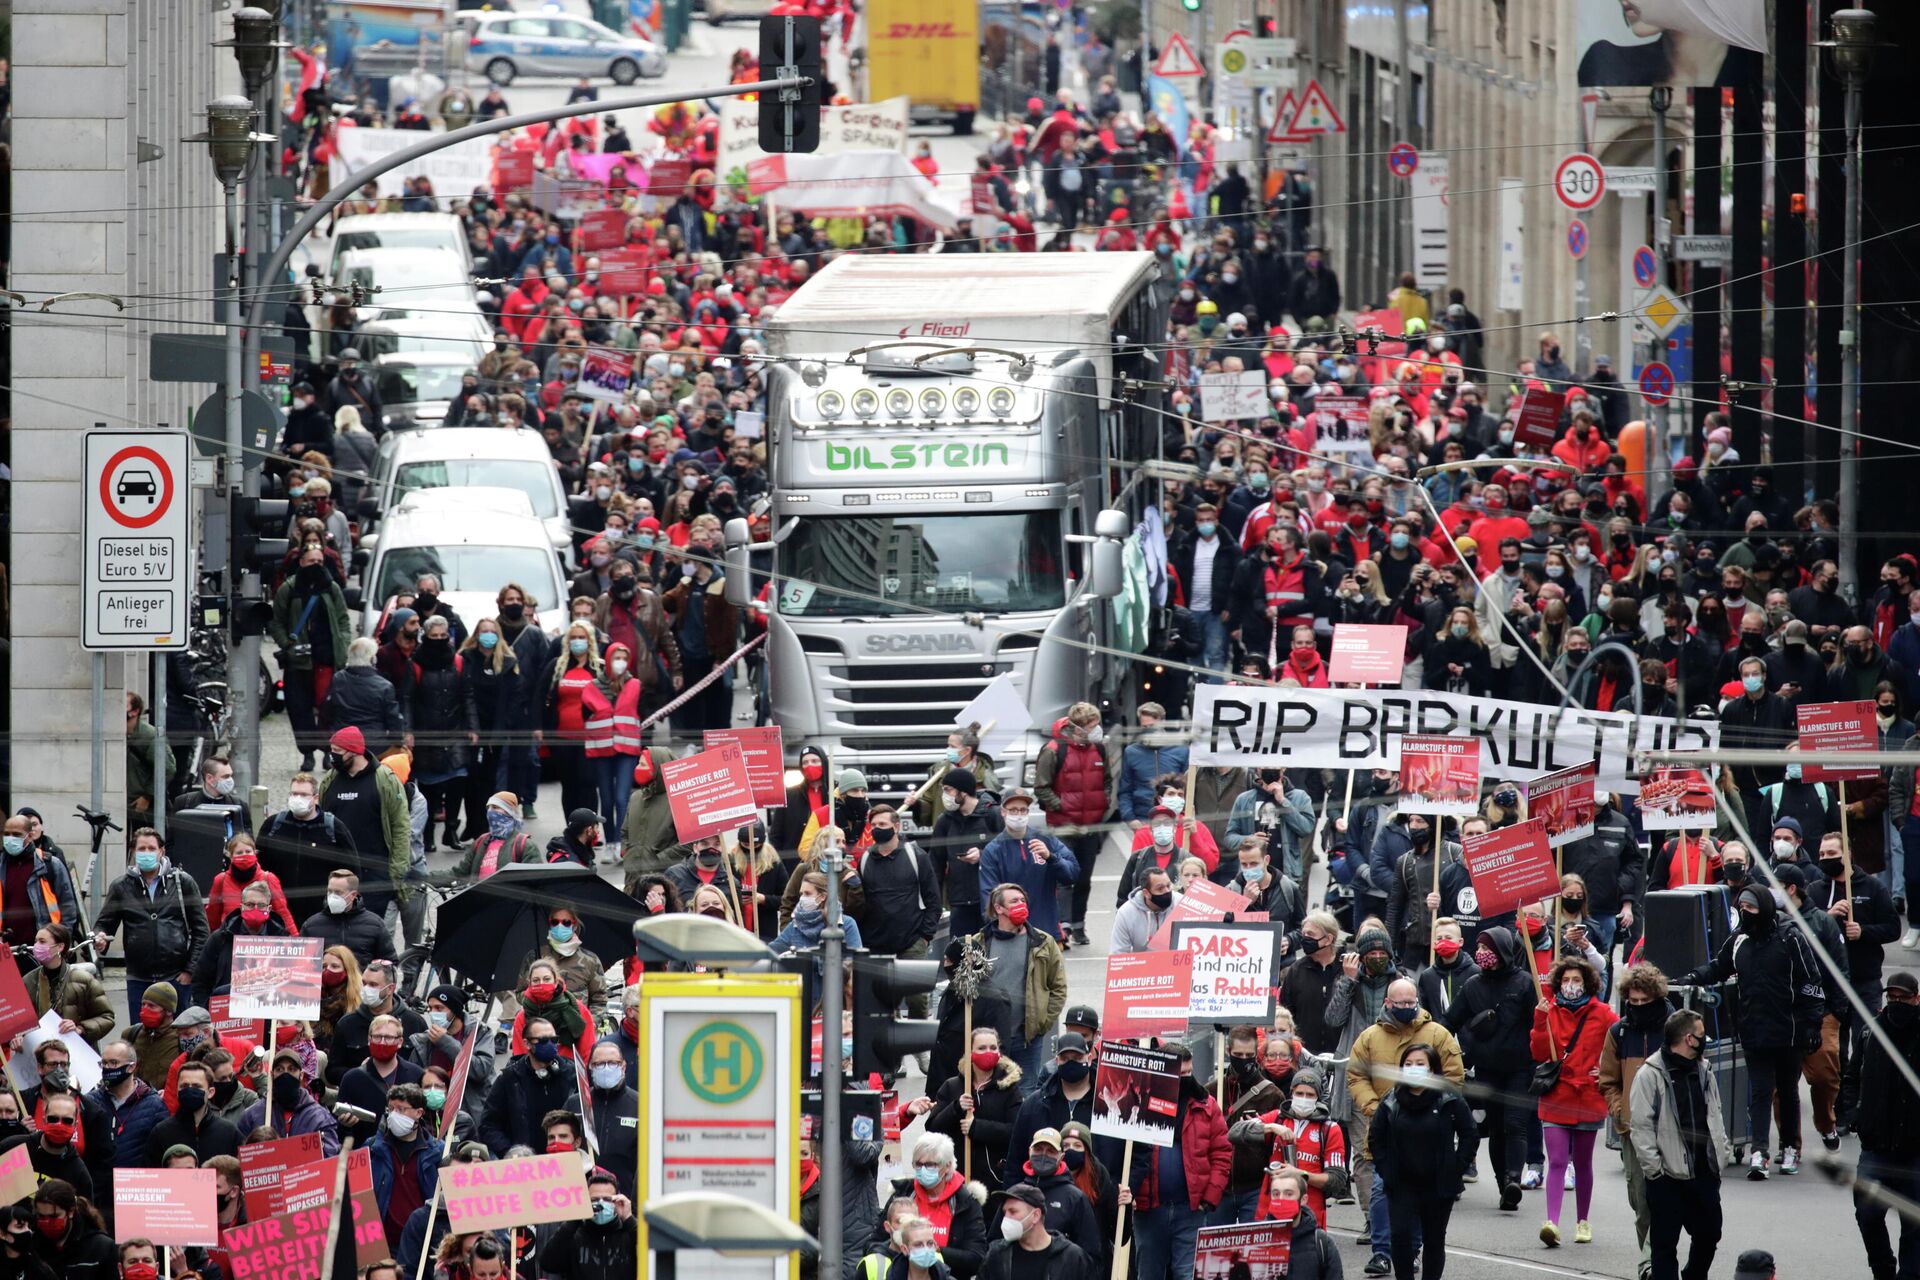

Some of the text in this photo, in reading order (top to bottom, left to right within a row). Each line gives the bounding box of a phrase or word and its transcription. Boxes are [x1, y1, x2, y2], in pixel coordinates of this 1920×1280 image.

[887, 22, 953, 39] DHL
[1565, 169, 1595, 195] 30
[920, 321, 971, 337] Fliegl
[103, 542, 169, 557] Diesel bis
[105, 562, 167, 576] Euro 5/V
[790, 588, 804, 604] 5
[106, 596, 165, 613] Anlieger
[124, 615, 148, 629] frei
[865, 633, 976, 652] SCANIA
[1855, 702, 1874, 714] 6/6
[1210, 700, 1318, 755] R.I.P.
[1800, 720, 1861, 734] ALARMSTUFE ROT!
[721, 747, 740, 761] 6/6
[1402, 743, 1465, 754] ALARMSTUFE ROT!
[669, 768, 730, 793] ALARMSTUFE ROT!
[1529, 773, 1582, 798] ALARMSTUFE ROT!
[1525, 819, 1545, 834] 3/6
[1472, 853, 1515, 873] AUSWEITEN!
[235, 945, 305, 956] ALARMSTUFE ROT!
[1187, 935, 1248, 957] BARS
[1172, 953, 1191, 967] 6/6
[1226, 957, 1264, 974] nicht
[1108, 975, 1174, 989] ALARMSTUFE ROT!
[1101, 1051, 1165, 1071] ALARMSTUFE ROT!
[301, 1135, 319, 1151] 5/6
[676, 1133, 691, 1143] M1
[348, 1152, 367, 1171] 2/6
[243, 1172, 280, 1188] BEENDEN!
[452, 1158, 563, 1188] #ALARM
[676, 1170, 691, 1180] M1
[115, 1193, 166, 1203] ANPASSEN!
[286, 1193, 328, 1214] ANPASSEN!
[449, 1185, 584, 1221] STUFE ROT
[224, 1218, 284, 1252] WIR
[1199, 1232, 1273, 1249] ALARMSTUFE ROT!
